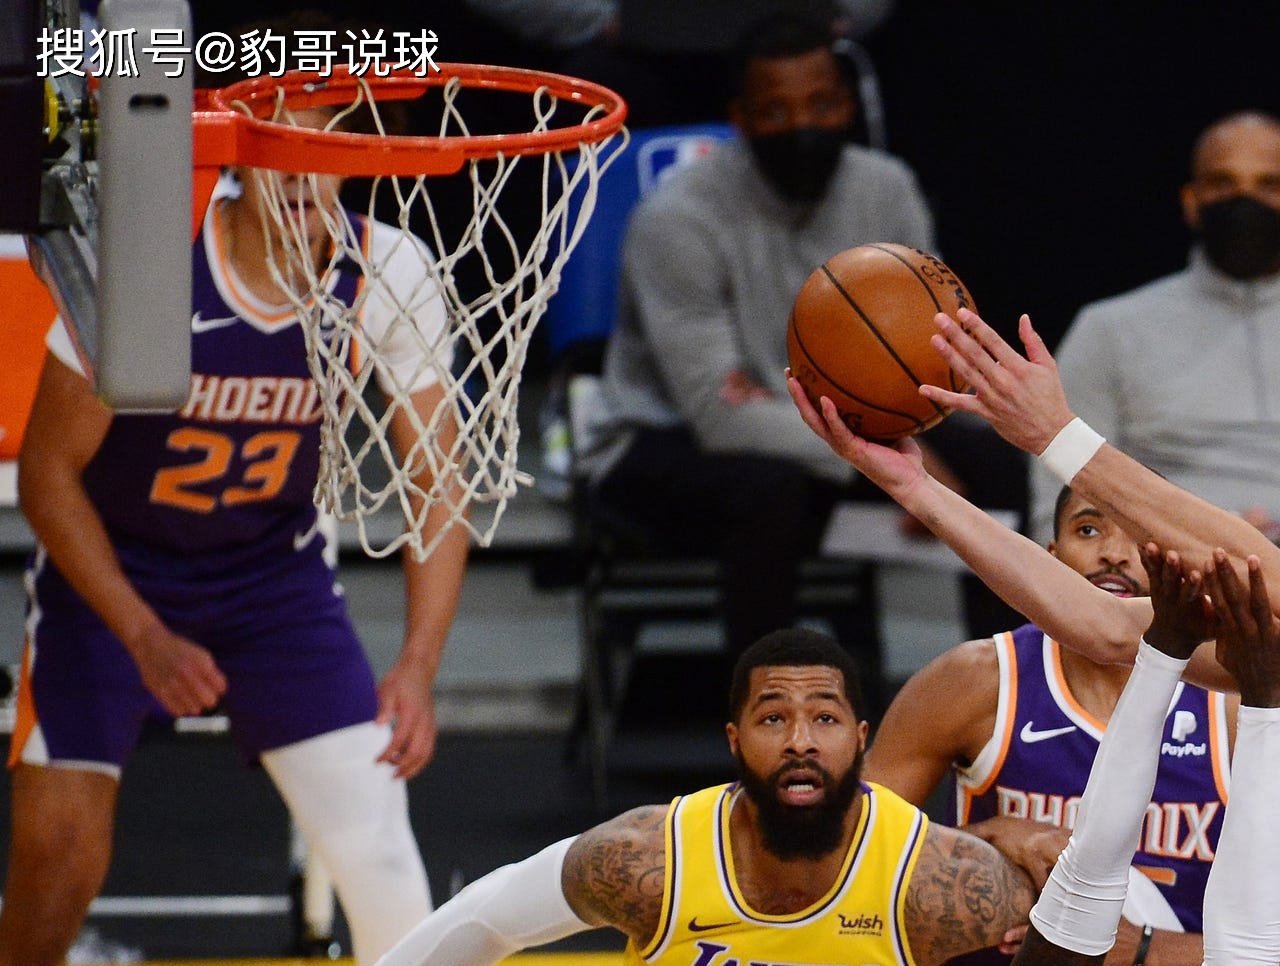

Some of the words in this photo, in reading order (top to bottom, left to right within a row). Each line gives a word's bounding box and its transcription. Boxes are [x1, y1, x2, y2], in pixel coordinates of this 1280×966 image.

[178, 373, 326, 425] HOENI
[151, 427, 301, 513] 23
[1161, 742, 1206, 758] PayPal
[838, 914, 883, 930] wish
